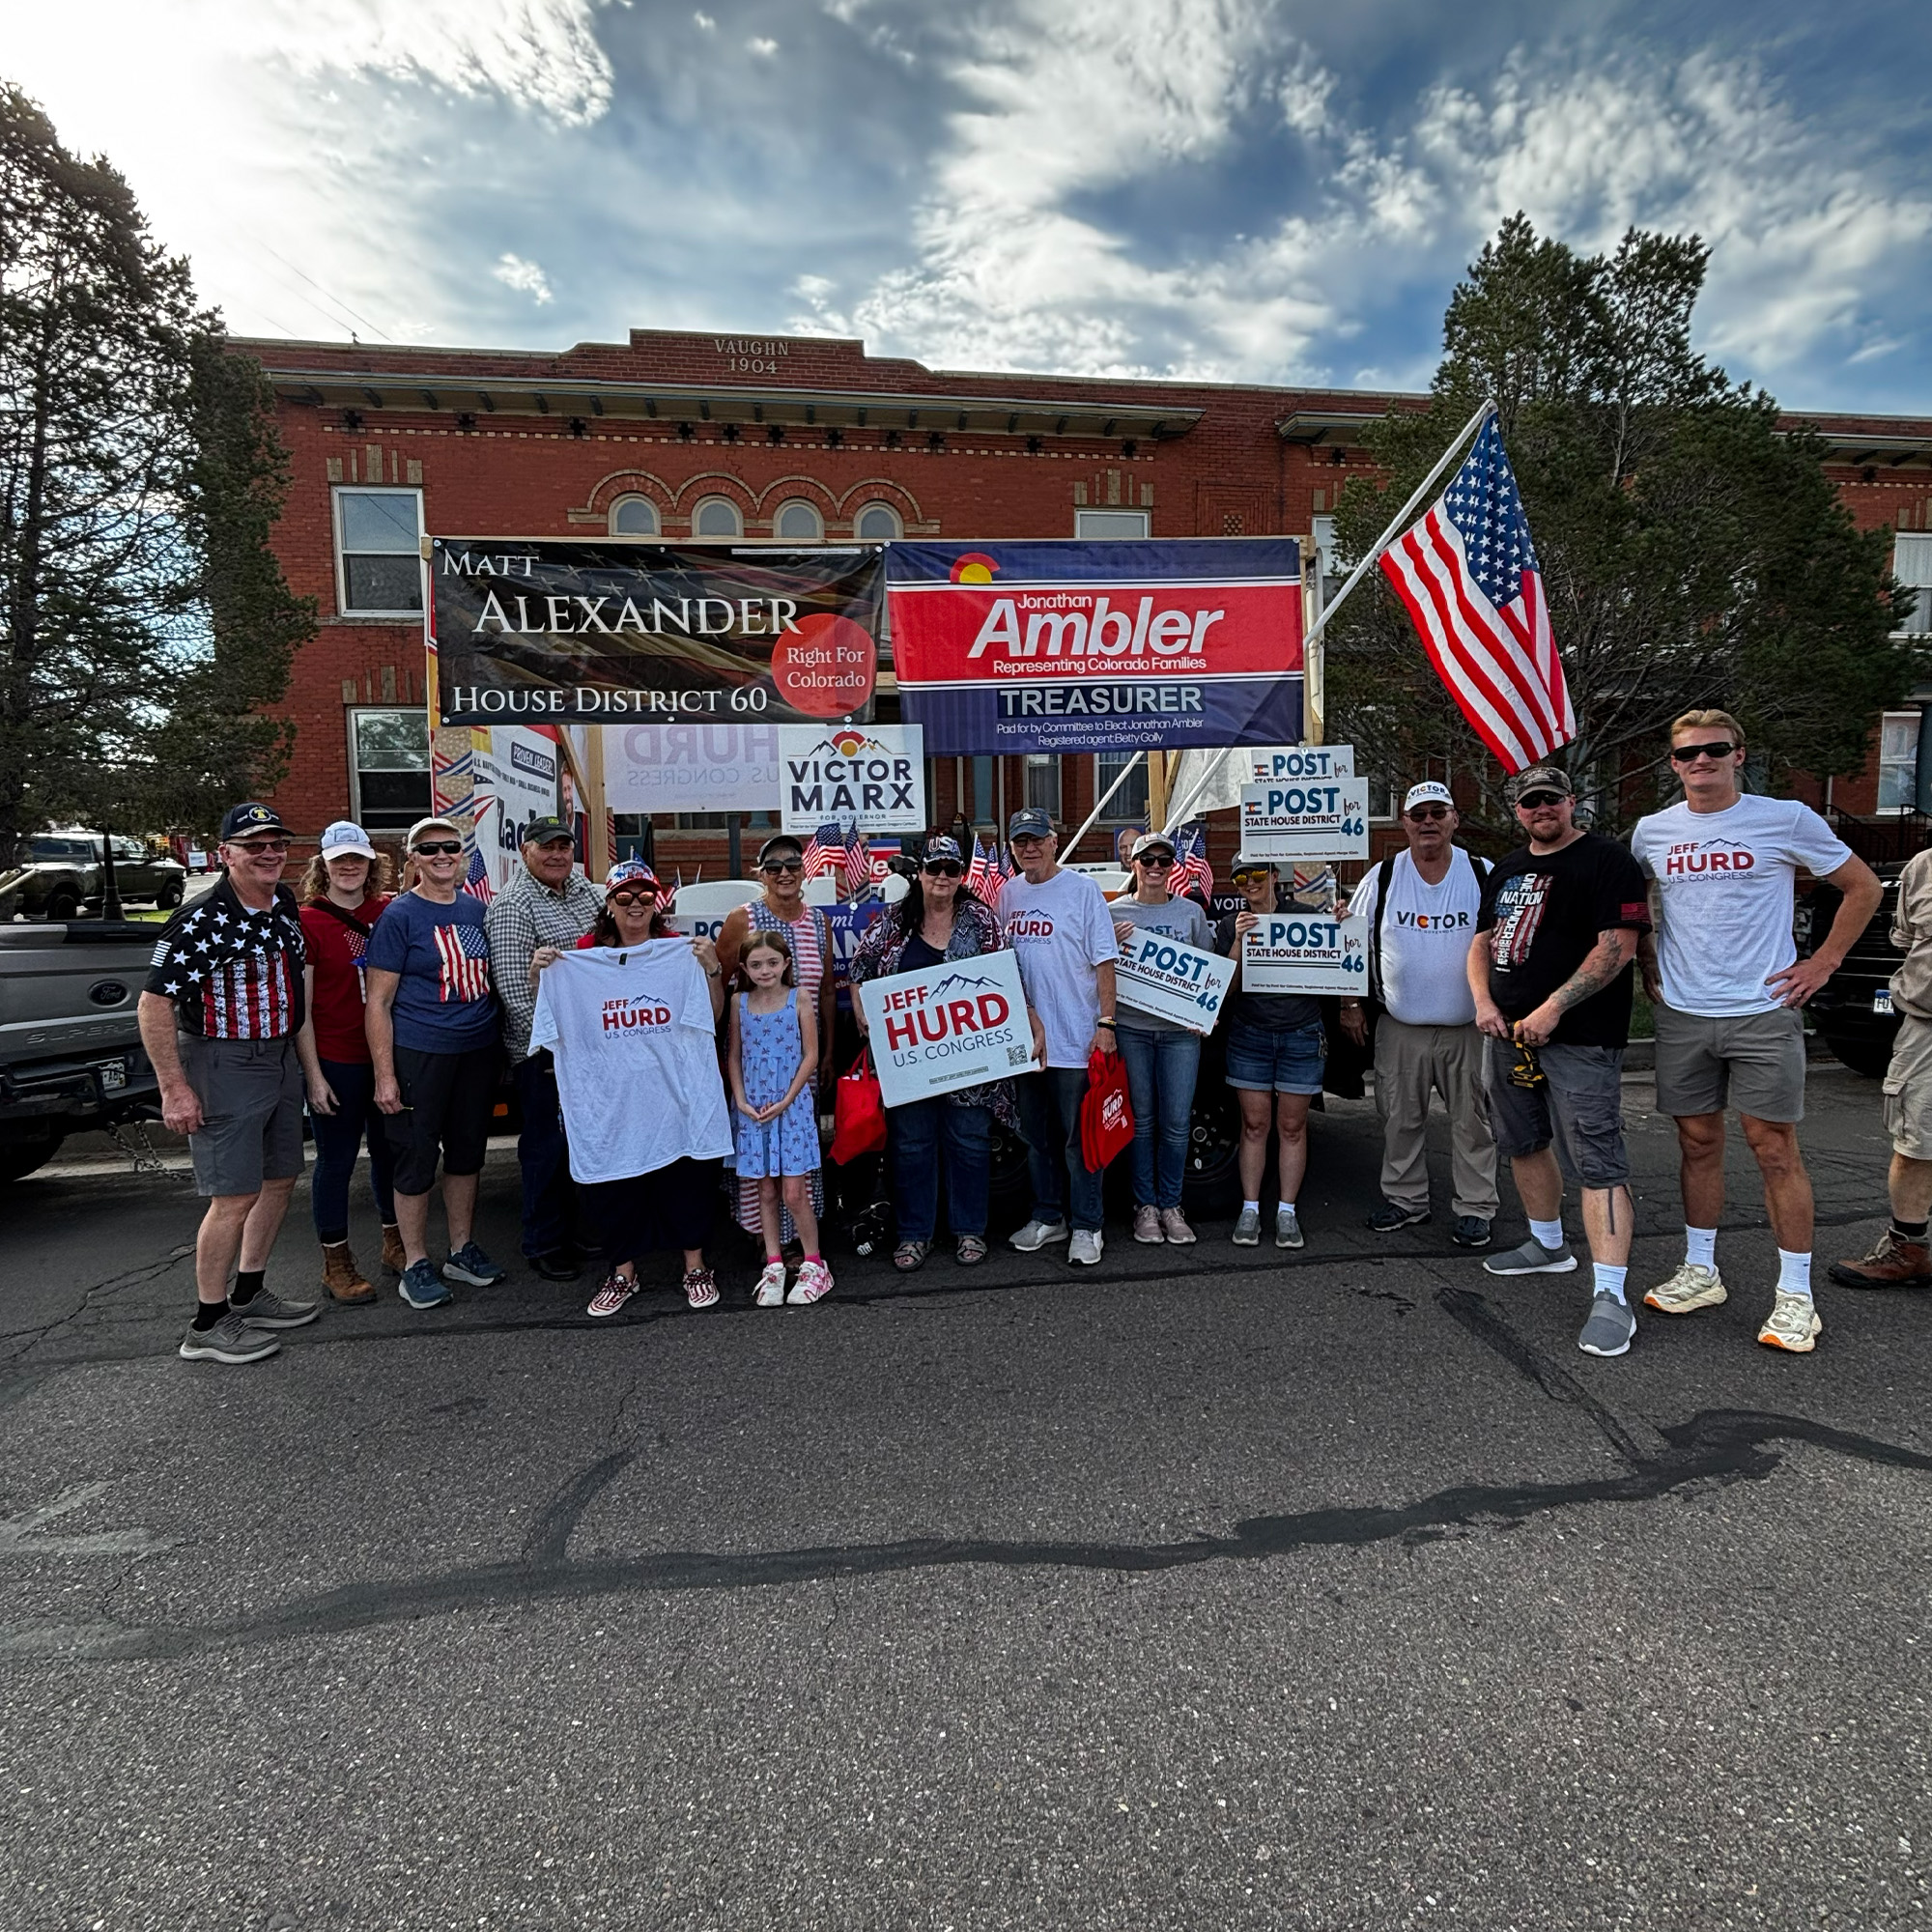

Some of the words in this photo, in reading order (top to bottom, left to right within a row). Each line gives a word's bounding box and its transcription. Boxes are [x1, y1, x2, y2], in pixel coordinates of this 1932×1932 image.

[714, 339, 788, 355] VAUGHN
[730, 357, 778, 374] 1904
[441, 549, 539, 577] MATT
[1017, 593, 1092, 609] Jonathan
[471, 589, 804, 635] ALEXANDER
[967, 596, 1225, 658] Ambler
[786, 647, 833, 668] Right
[836, 646, 866, 663] For
[993, 659, 1086, 675] Representing
[1088, 657, 1150, 670] Colorado
[1151, 656, 1207, 670] Families
[786, 671, 867, 689] Colorado
[452, 687, 566, 713] HOUSE
[575, 687, 723, 713] DISTRICT
[730, 687, 768, 712] 60
[1000, 687, 1203, 715] TREASURER
[997, 724, 1016, 734] Paid
[1017, 723, 1030, 733] for
[1031, 723, 1042, 734] by
[1043, 722, 1094, 733] Committee
[1094, 722, 1104, 731] to
[1105, 720, 1127, 730] Elect
[1128, 719, 1171, 730] Jonathan
[1172, 718, 1204, 728] Ambler
[1038, 735, 1086, 748] Registered
[1115, 733, 1140, 744] Betty
[1141, 732, 1163, 743] Golly
[787, 759, 913, 783] VICTOR
[1272, 753, 1331, 777] POST
[791, 783, 915, 811] MARX
[1410, 784, 1445, 796] VICTOR
[1268, 787, 1341, 816] POST
[1344, 798, 1361, 816] for
[1244, 817, 1269, 827] STATE
[1270, 816, 1300, 826] HOUSE
[1302, 814, 1342, 824] DISTRICT
[1341, 817, 1364, 837] 46
[928, 836, 959, 853] USA
[1667, 842, 1699, 856] JEFF
[1666, 851, 1755, 876] HURD
[1520, 873, 1537, 893] ONE
[1689, 871, 1754, 882] CONGRESS
[1213, 897, 1247, 911] VOTE
[1500, 891, 1545, 906] NATION
[1008, 921, 1054, 936] HURD
[1397, 911, 1469, 929] VICTOR
[1501, 905, 1525, 941] UNDER
[1270, 922, 1341, 949] POST
[1344, 934, 1361, 952] for
[1246, 949, 1270, 957] STATE
[1272, 949, 1301, 957] HOUSE
[1303, 949, 1342, 959] DISTRICT
[1341, 954, 1364, 973] 46
[1139, 940, 1208, 981] POST
[1205, 973, 1221, 990] for
[1137, 962, 1164, 981] HOUSE
[1165, 974, 1202, 993] DISTRICT
[100, 985, 121, 1000] Ford
[882, 985, 929, 1013] JEFF
[1196, 992, 1218, 1011] 46
[602, 999, 629, 1010] JEFF
[602, 1007, 671, 1031] HURD
[885, 993, 1009, 1051] HURD
[622, 1025, 671, 1038] CONGRESS
[893, 1050, 923, 1067] U.S.
[924, 1028, 1013, 1060] CONGRESS
